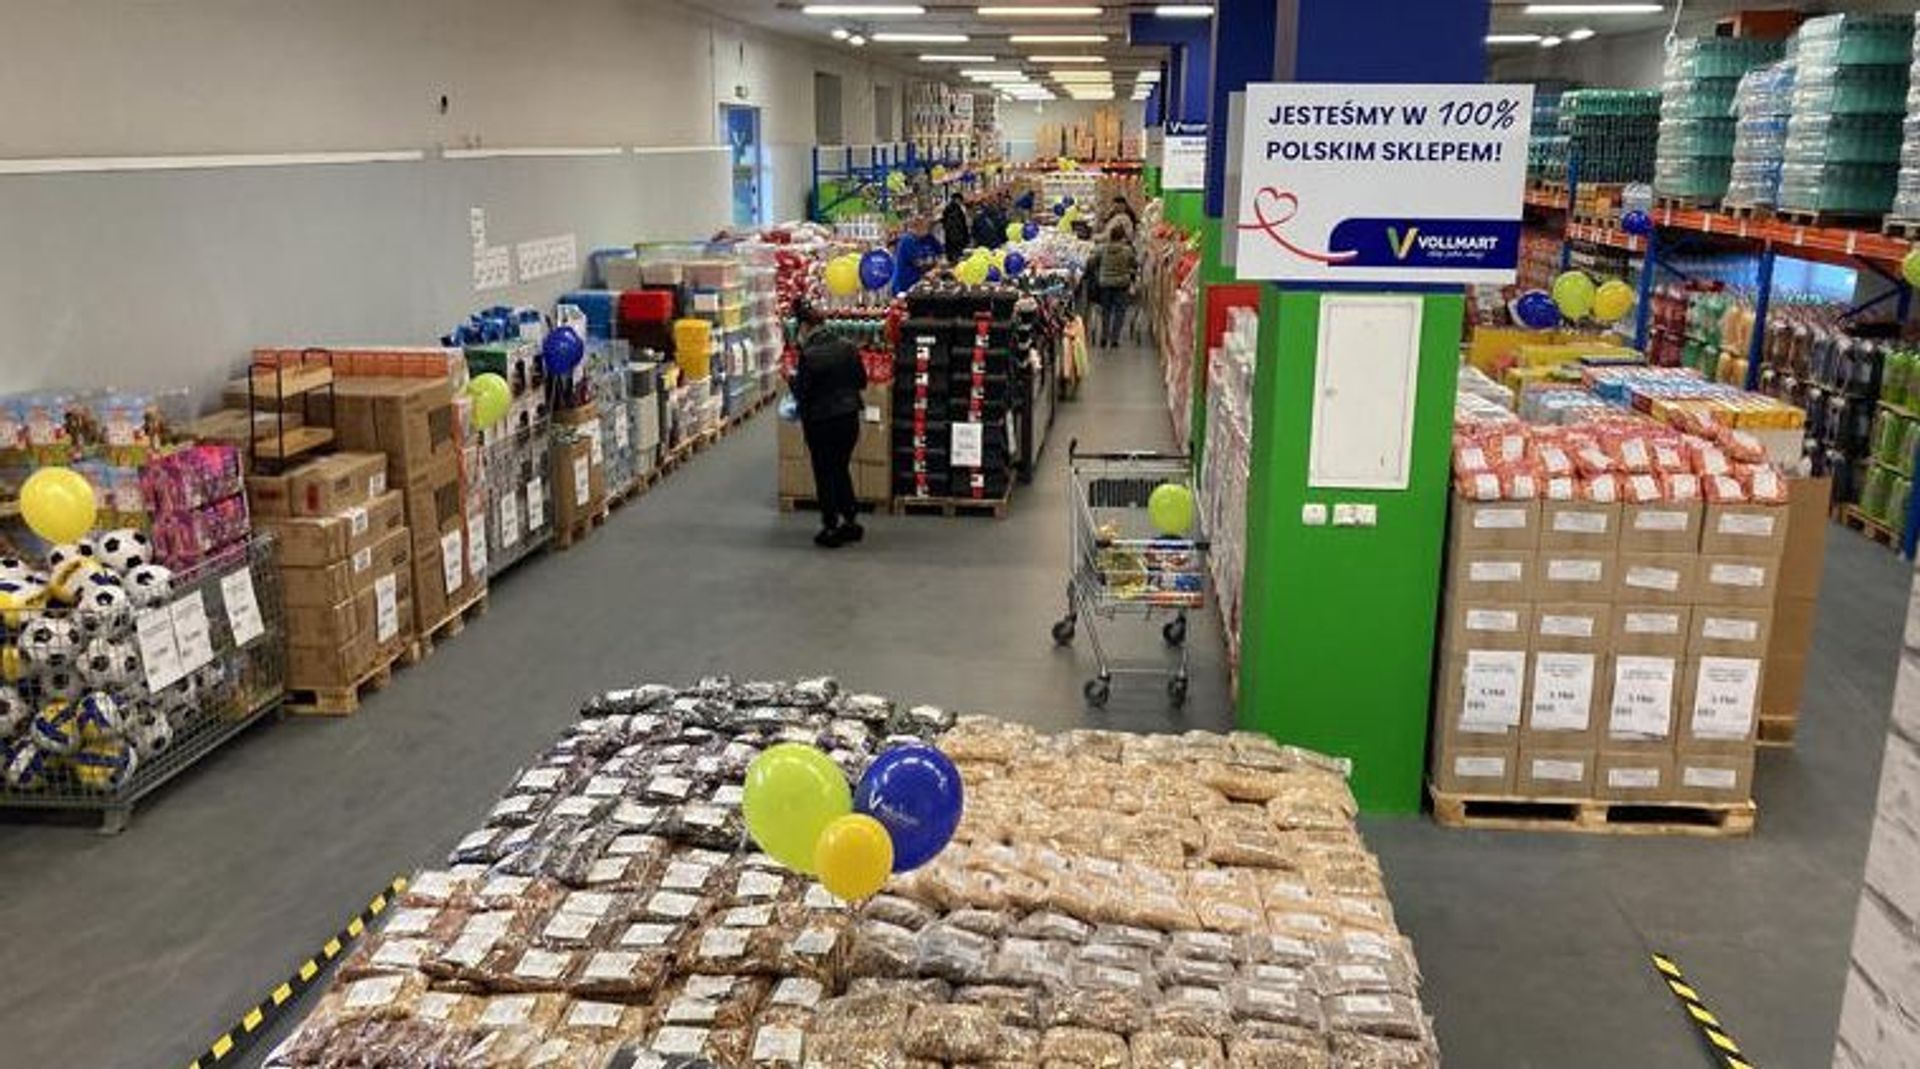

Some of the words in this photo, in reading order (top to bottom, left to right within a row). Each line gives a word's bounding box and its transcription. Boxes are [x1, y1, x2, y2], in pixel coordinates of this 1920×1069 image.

[1268, 100, 1395, 126] JESTEŚMY
[1402, 106, 1427, 126] W
[1438, 99, 1519, 130] 100%
[1266, 141, 1374, 161] POLSKIM
[1381, 141, 1502, 162] SKLEPEM!
[1418, 235, 1498, 250] VOLLMART
